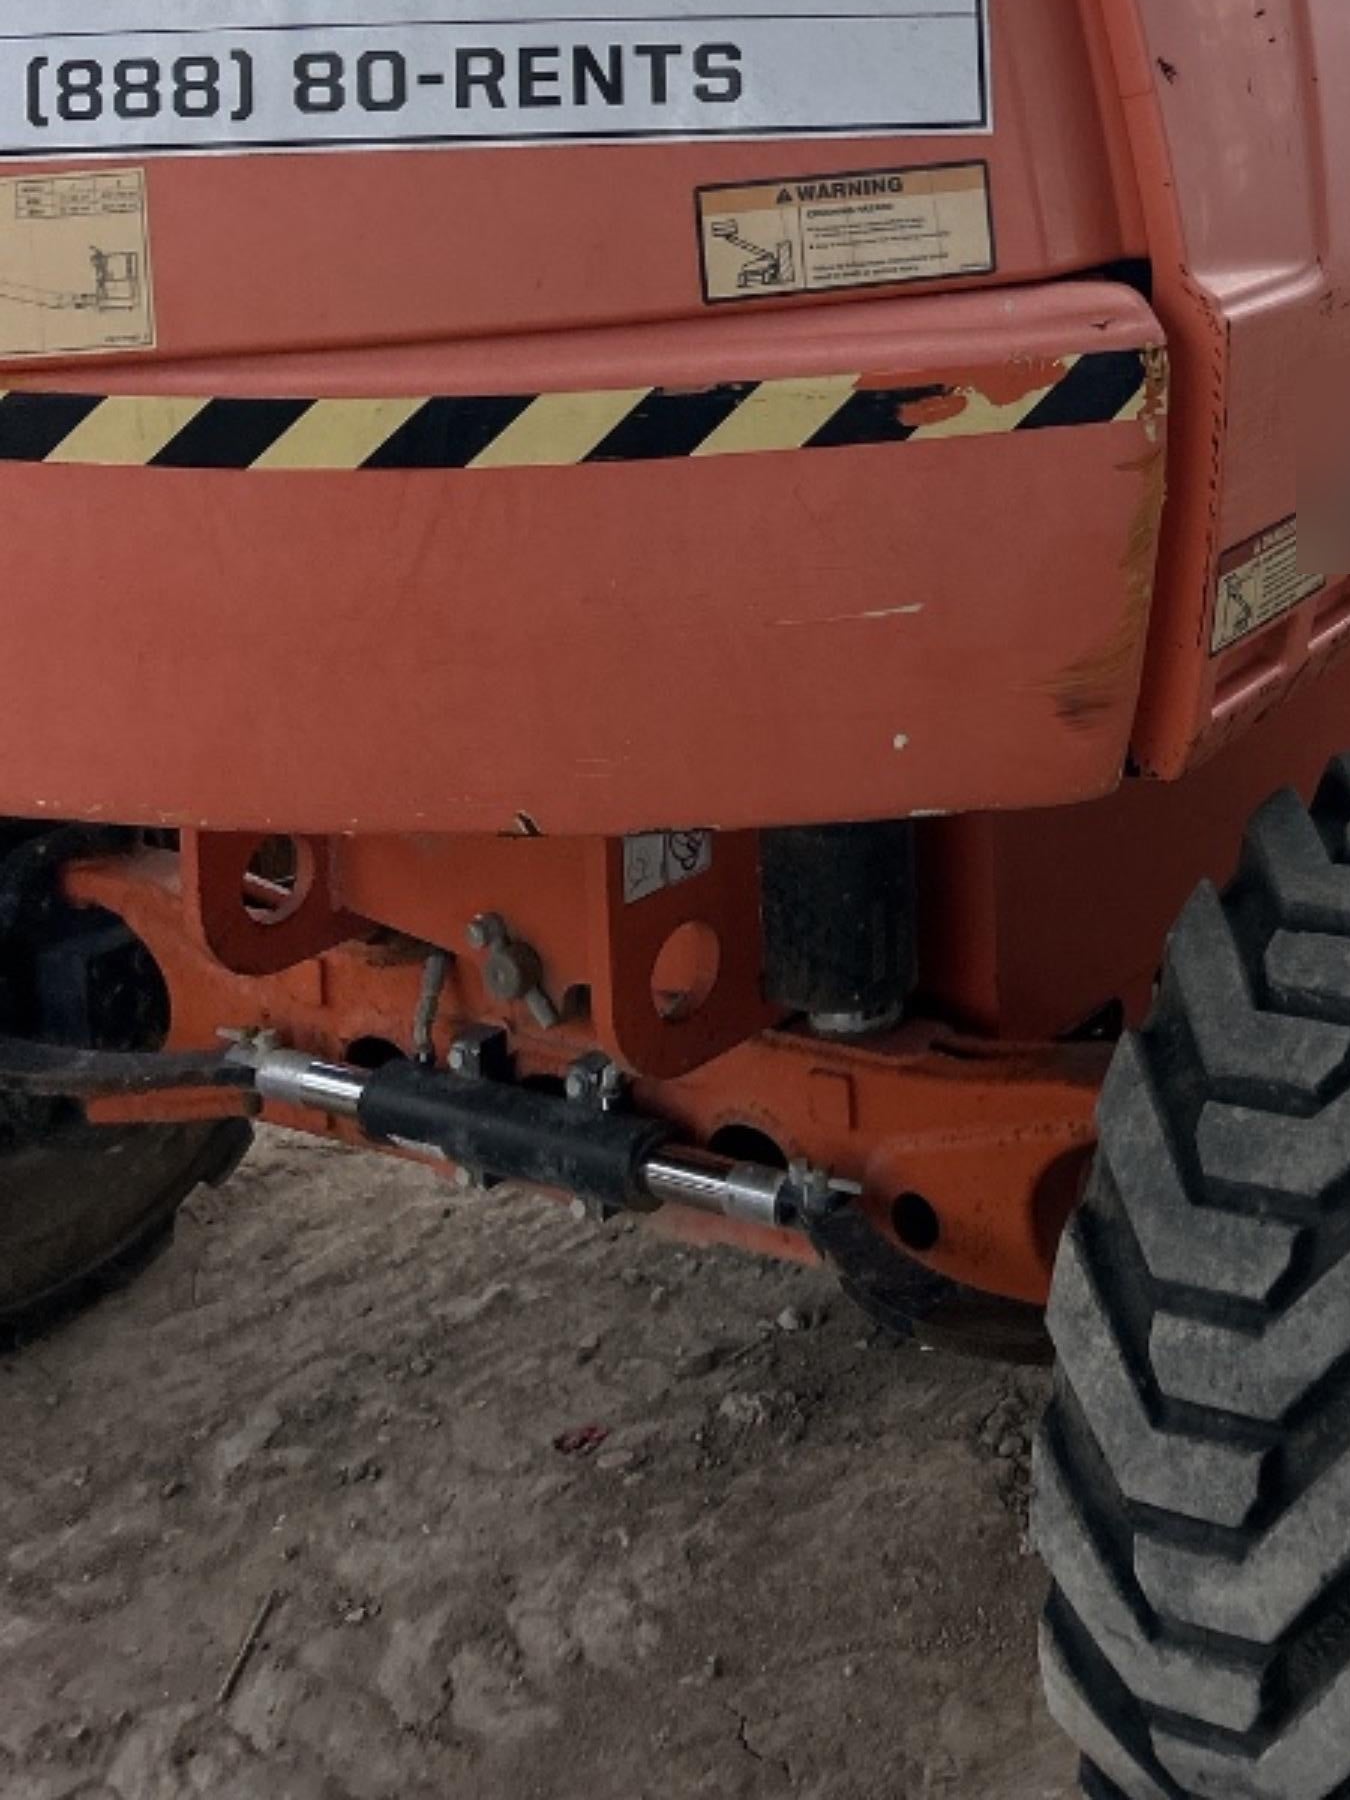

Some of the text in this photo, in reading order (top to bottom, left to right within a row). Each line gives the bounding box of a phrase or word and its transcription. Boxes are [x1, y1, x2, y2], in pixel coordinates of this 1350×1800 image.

[26, 42, 745, 127] (888) 80-RENTS
[797, 177, 903, 202] WARNING
